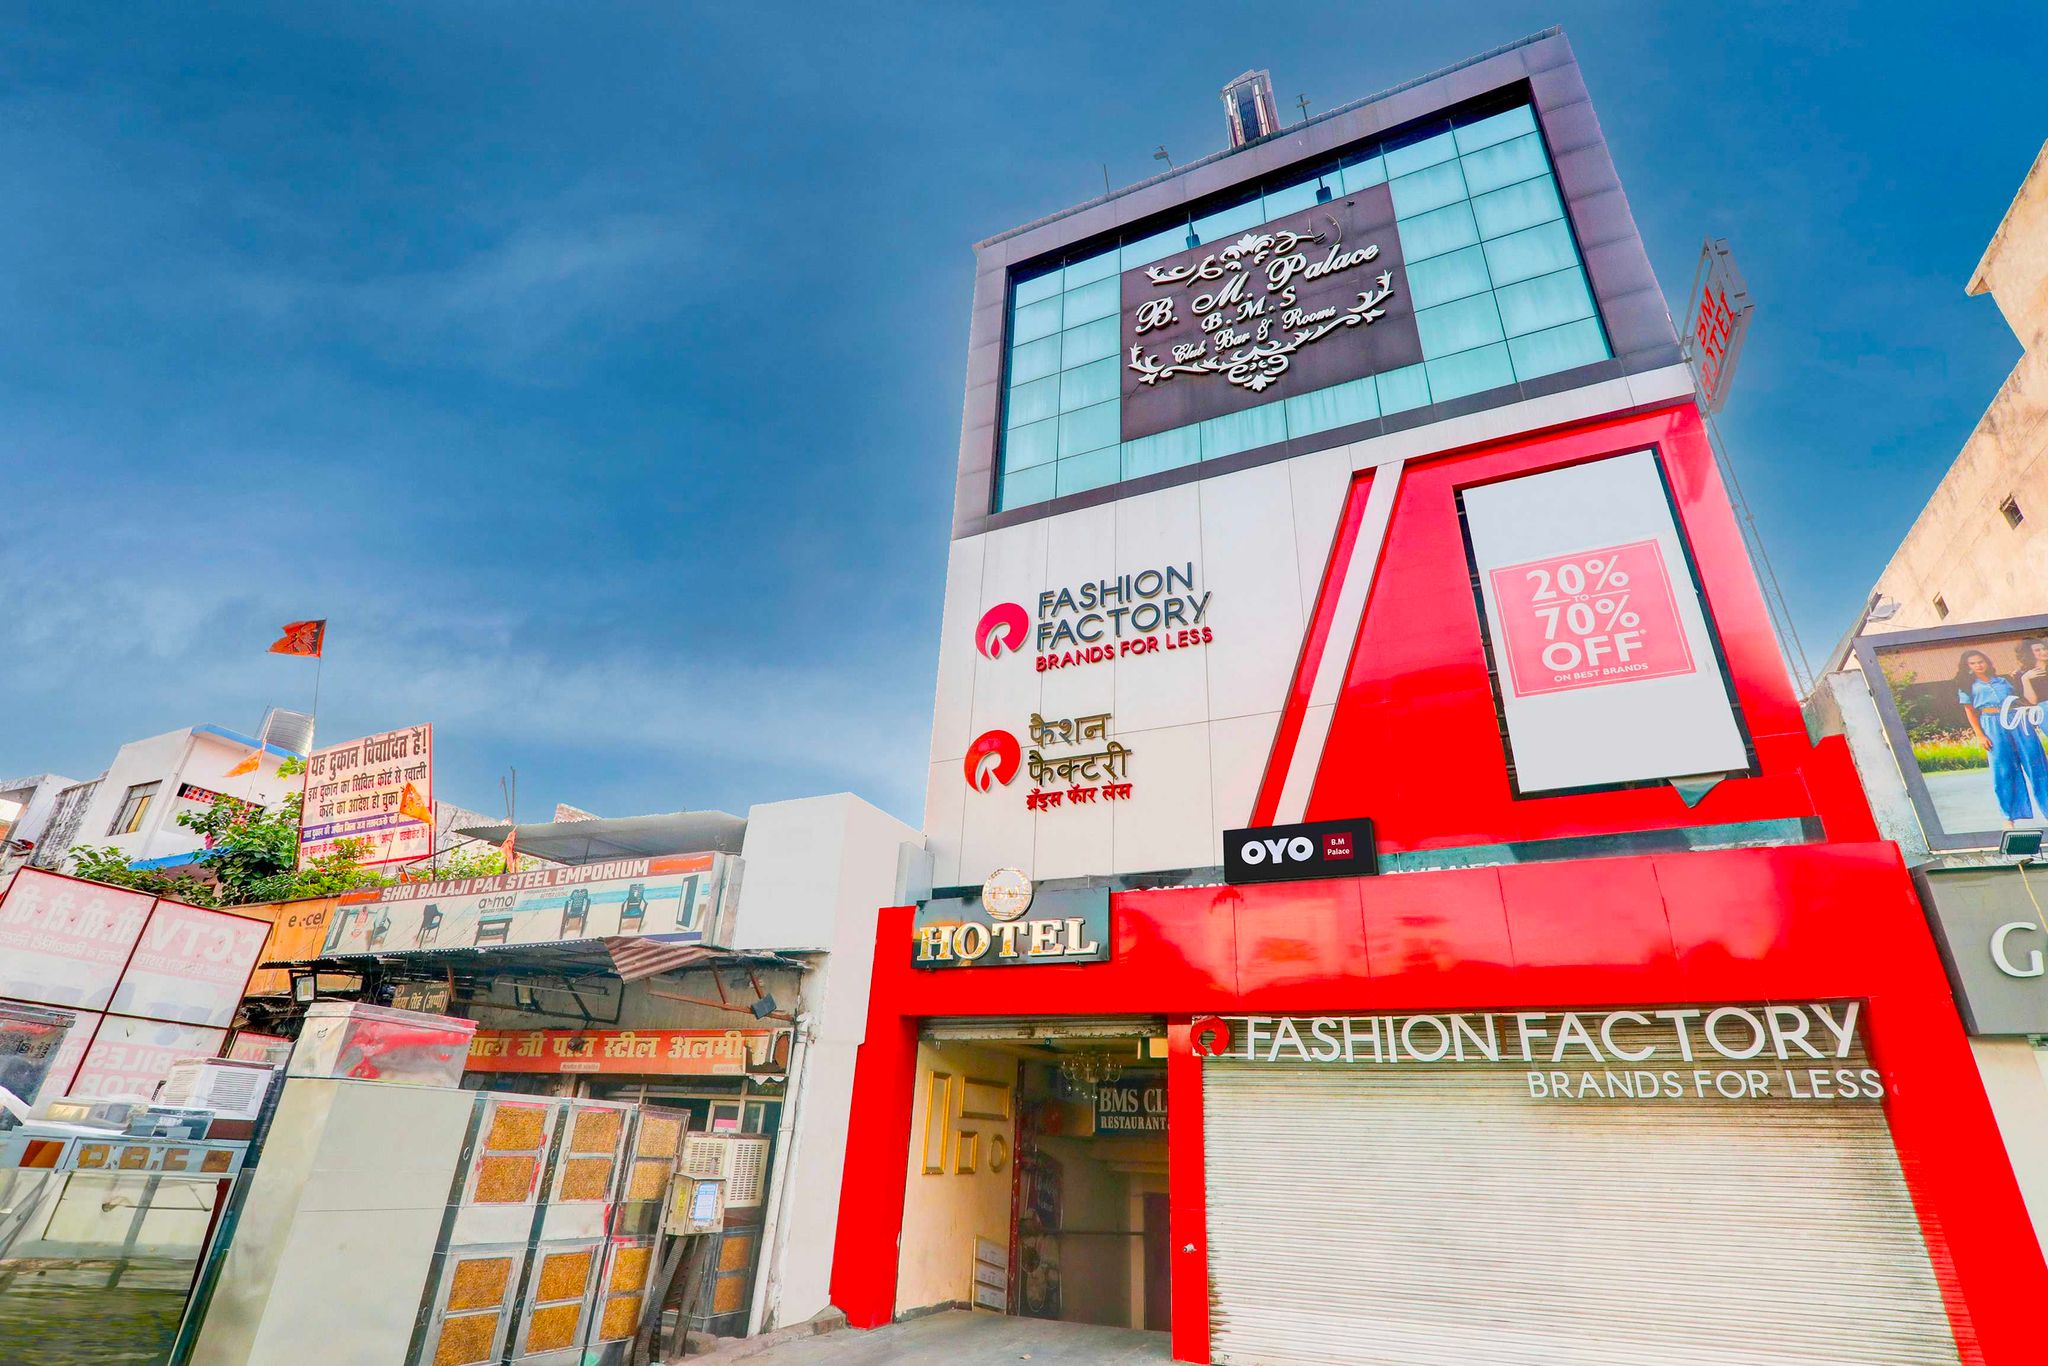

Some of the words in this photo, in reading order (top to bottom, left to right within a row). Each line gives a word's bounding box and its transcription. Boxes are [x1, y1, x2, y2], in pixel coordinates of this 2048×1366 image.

[1265, 243, 1380, 292] Palace
[1171, 339, 1207, 364] Club
[1214, 326, 1251, 351] Bar
[1282, 304, 1337, 331] Rooms
[1038, 561, 1194, 620] FASHION
[1526, 555, 1629, 601] 20%
[1572, 594, 1590, 602] TO
[1036, 591, 1212, 651] FACTORY
[1534, 595, 1640, 640] 70%
[1035, 644, 1115, 673] BRANDS
[1119, 636, 1158, 657] FOR
[1165, 626, 1214, 650] LESS
[1554, 673, 1571, 682] ON
[1573, 668, 1600, 679] BEST
[1602, 663, 1649, 675] BRANDS
[1029, 713, 1112, 749] फैशन
[311, 754, 327, 777] यह
[329, 745, 360, 781] दुकान
[363, 732, 409, 767] विवादित
[1028, 741, 1133, 787] फैक्टरी
[308, 786, 318, 803] इस
[320, 782, 339, 804] दुकान
[340, 780, 350, 793] का
[352, 773, 375, 792] सिविल
[377, 767, 393, 787] कोर्ट
[394, 767, 402, 784] से
[319, 800, 334, 818] करने
[336, 801, 346, 814] का
[348, 794, 370, 813] आदेश
[372, 791, 380, 809] हो
[382, 791, 399, 812] चुका
[1101, 781, 1133, 801] लेस
[1241, 836, 1314, 865] OYO
[1330, 838, 1345, 846] B.M
[381, 884, 416, 902] SHRI
[416, 879, 471, 899] BALAJI
[472, 876, 502, 894] PAL
[505, 870, 552, 890] STEEL
[555, 860, 650, 885] EMPORIUM
[917, 917, 1100, 961] HOTEL
[517, 1031, 548, 1057] जी
[604, 1031, 660, 1058] स्टील
[1247, 1012, 1500, 1064] FASHION
[1518, 1001, 1860, 1063] FACTORY
[1099, 1087, 1139, 1112] BMS
[1143, 1088, 1168, 1113] CL
[1527, 1069, 1683, 1099] BRANDS
[1696, 1069, 1769, 1099] FOR
[1789, 1069, 1884, 1099] LESS
